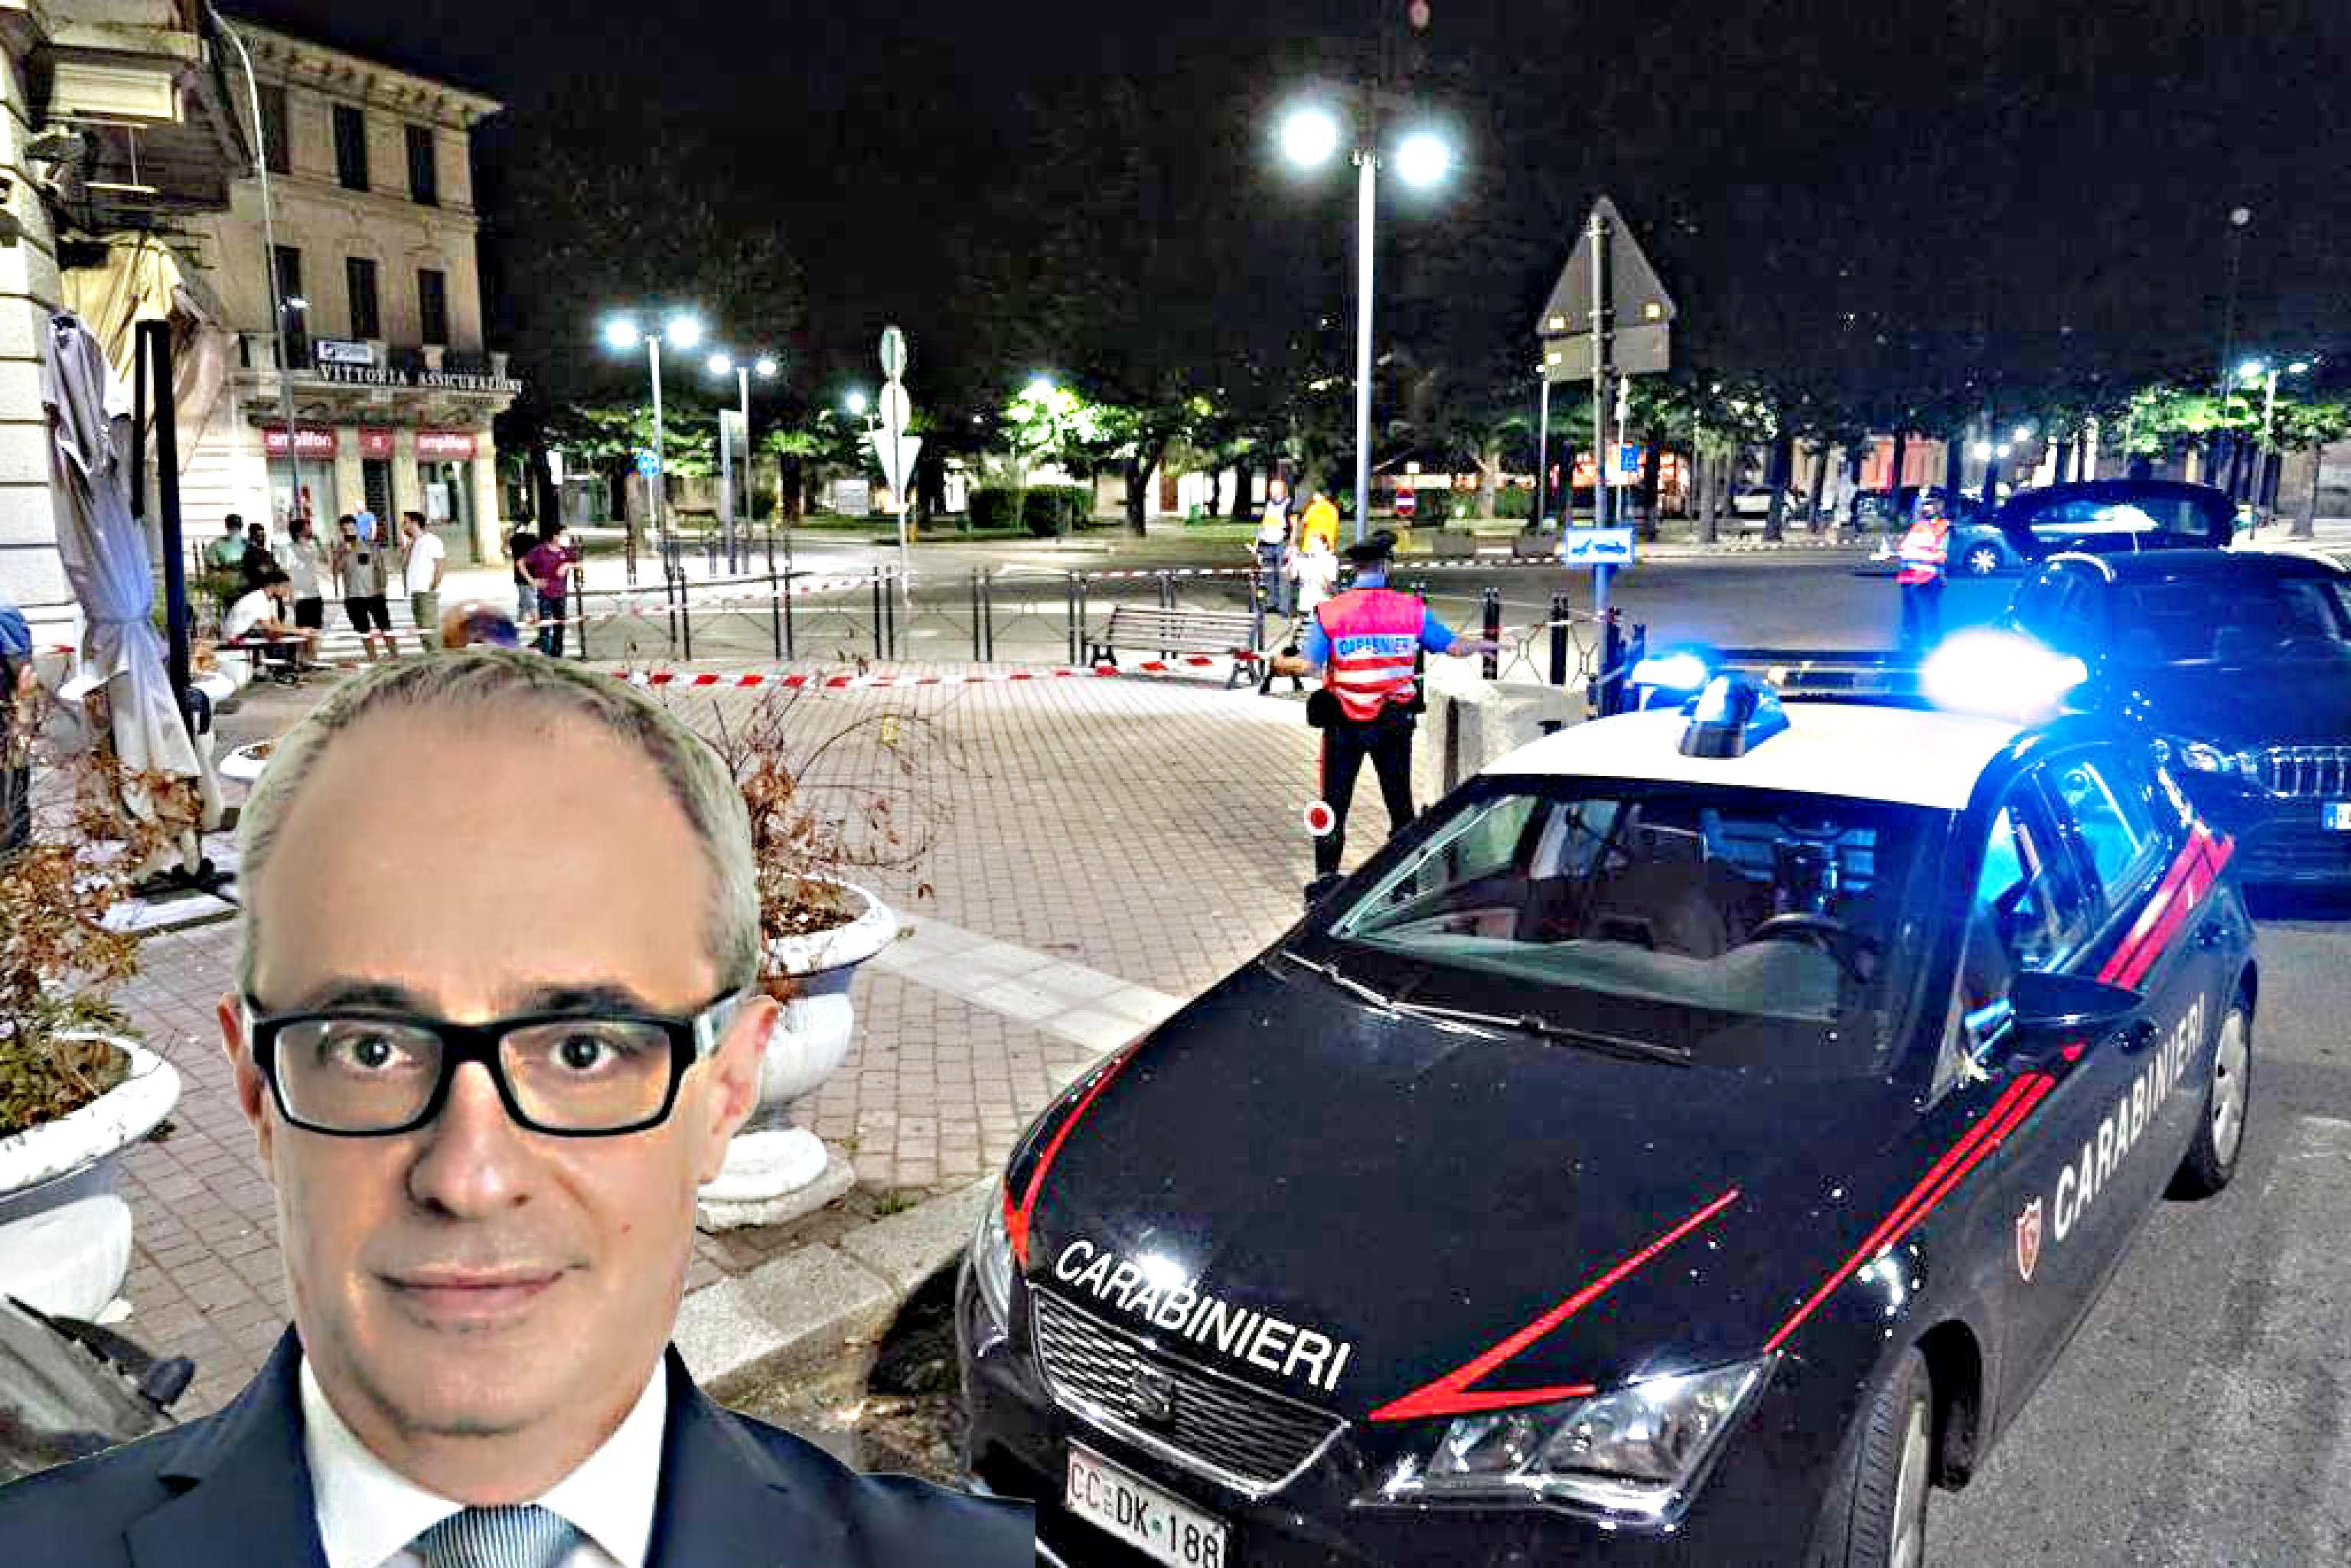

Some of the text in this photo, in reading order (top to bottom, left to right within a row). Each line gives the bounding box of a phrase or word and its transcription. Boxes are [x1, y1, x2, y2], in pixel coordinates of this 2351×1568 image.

[319, 363, 407, 386] VITTORIA
[2055, 992, 2205, 1241] CARABINIERI
[1055, 1240, 1352, 1391] CARABINIERI
[1071, 1463, 1101, 1508] CC
[1117, 1486, 1149, 1539] DK
